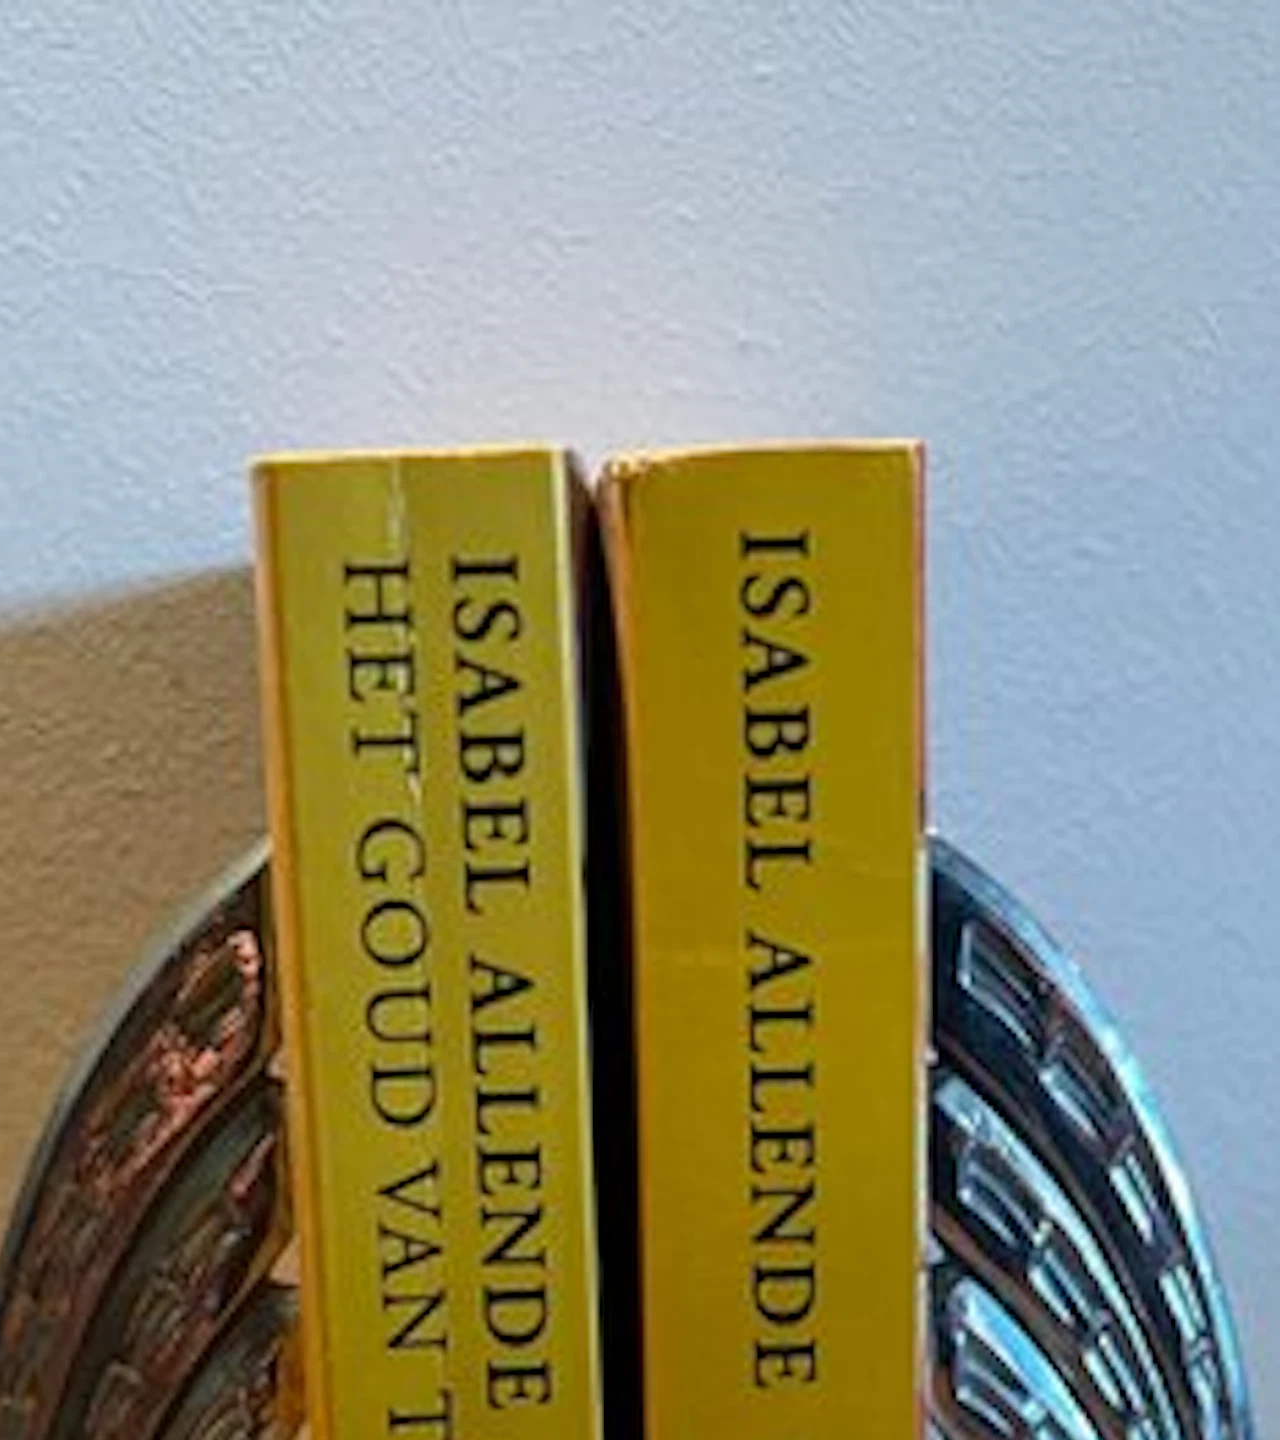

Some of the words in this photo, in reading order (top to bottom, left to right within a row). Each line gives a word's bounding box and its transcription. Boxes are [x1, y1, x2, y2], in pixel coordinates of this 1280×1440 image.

[344, 561, 420, 775] HET
[451, 555, 529, 914] ISABEL
[740, 530, 813, 890] ISABEL
[356, 819, 436, 1127] GOUD
[377, 1161, 447, 1355] VAN
[470, 954, 552, 1410] ALLENDE
[746, 932, 816, 1388] ALLENDE
